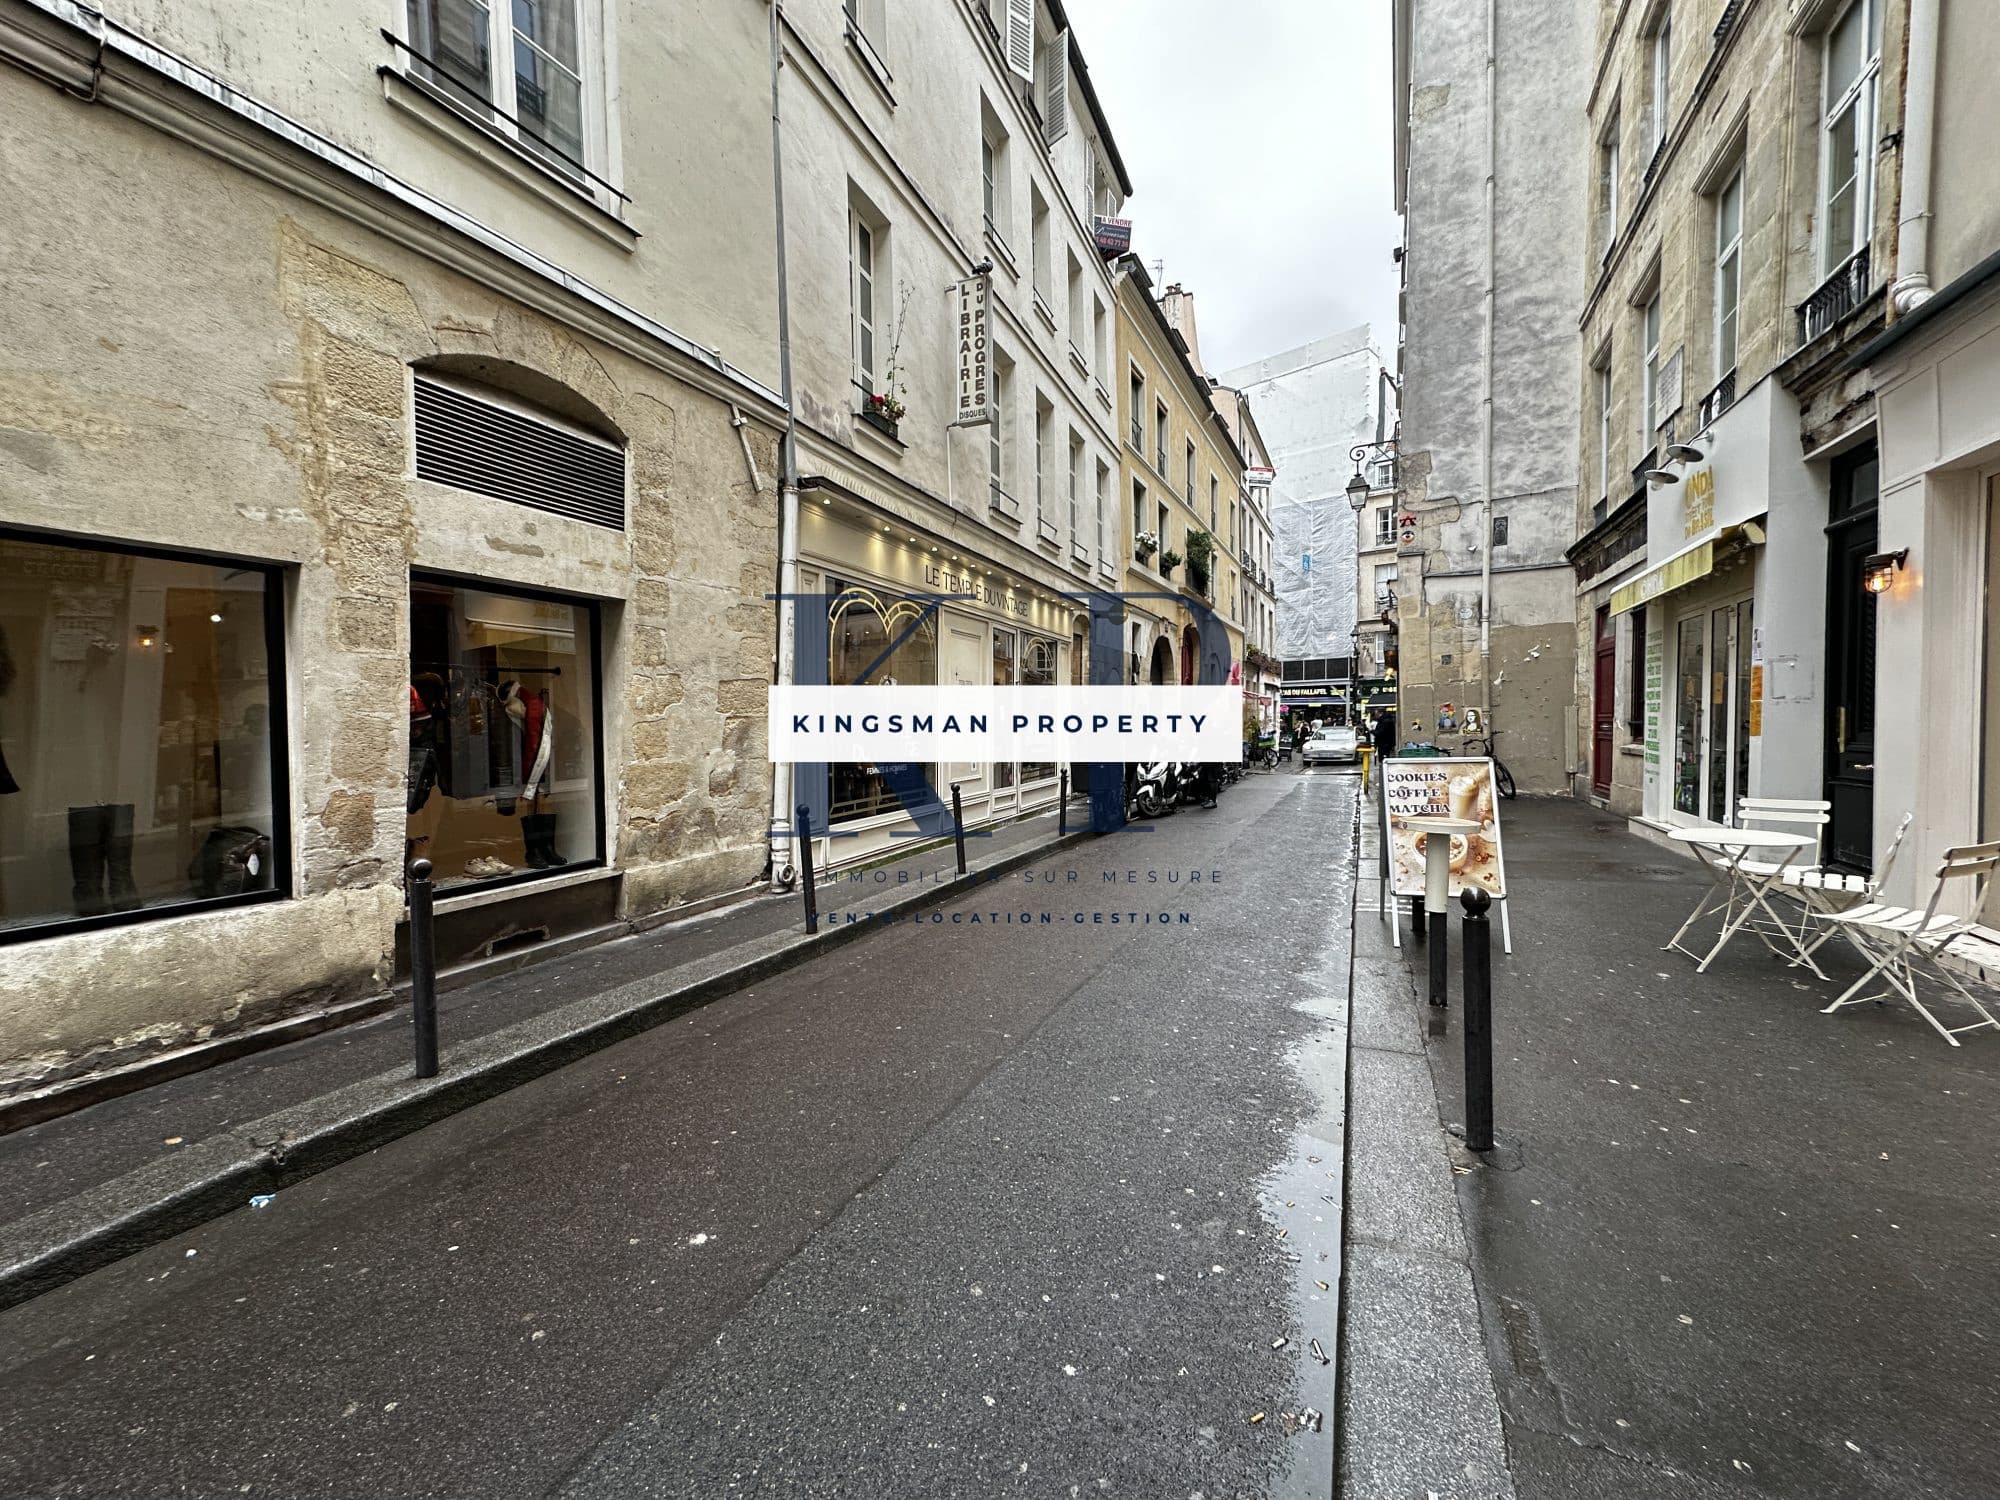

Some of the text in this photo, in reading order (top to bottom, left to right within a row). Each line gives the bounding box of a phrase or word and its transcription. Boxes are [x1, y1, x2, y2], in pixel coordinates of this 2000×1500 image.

[960, 283, 971, 408] LIBRAIRIE
[974, 282, 986, 406] DU PROGRES
[960, 408, 986, 420] DISQUES
[925, 564, 1028, 617] LE TEMPLE DU VINTAGE
[1387, 772, 1448, 783] COOKIES
[1388, 787, 1441, 799] COFFEE
[1389, 803, 1451, 813] MATCHA
